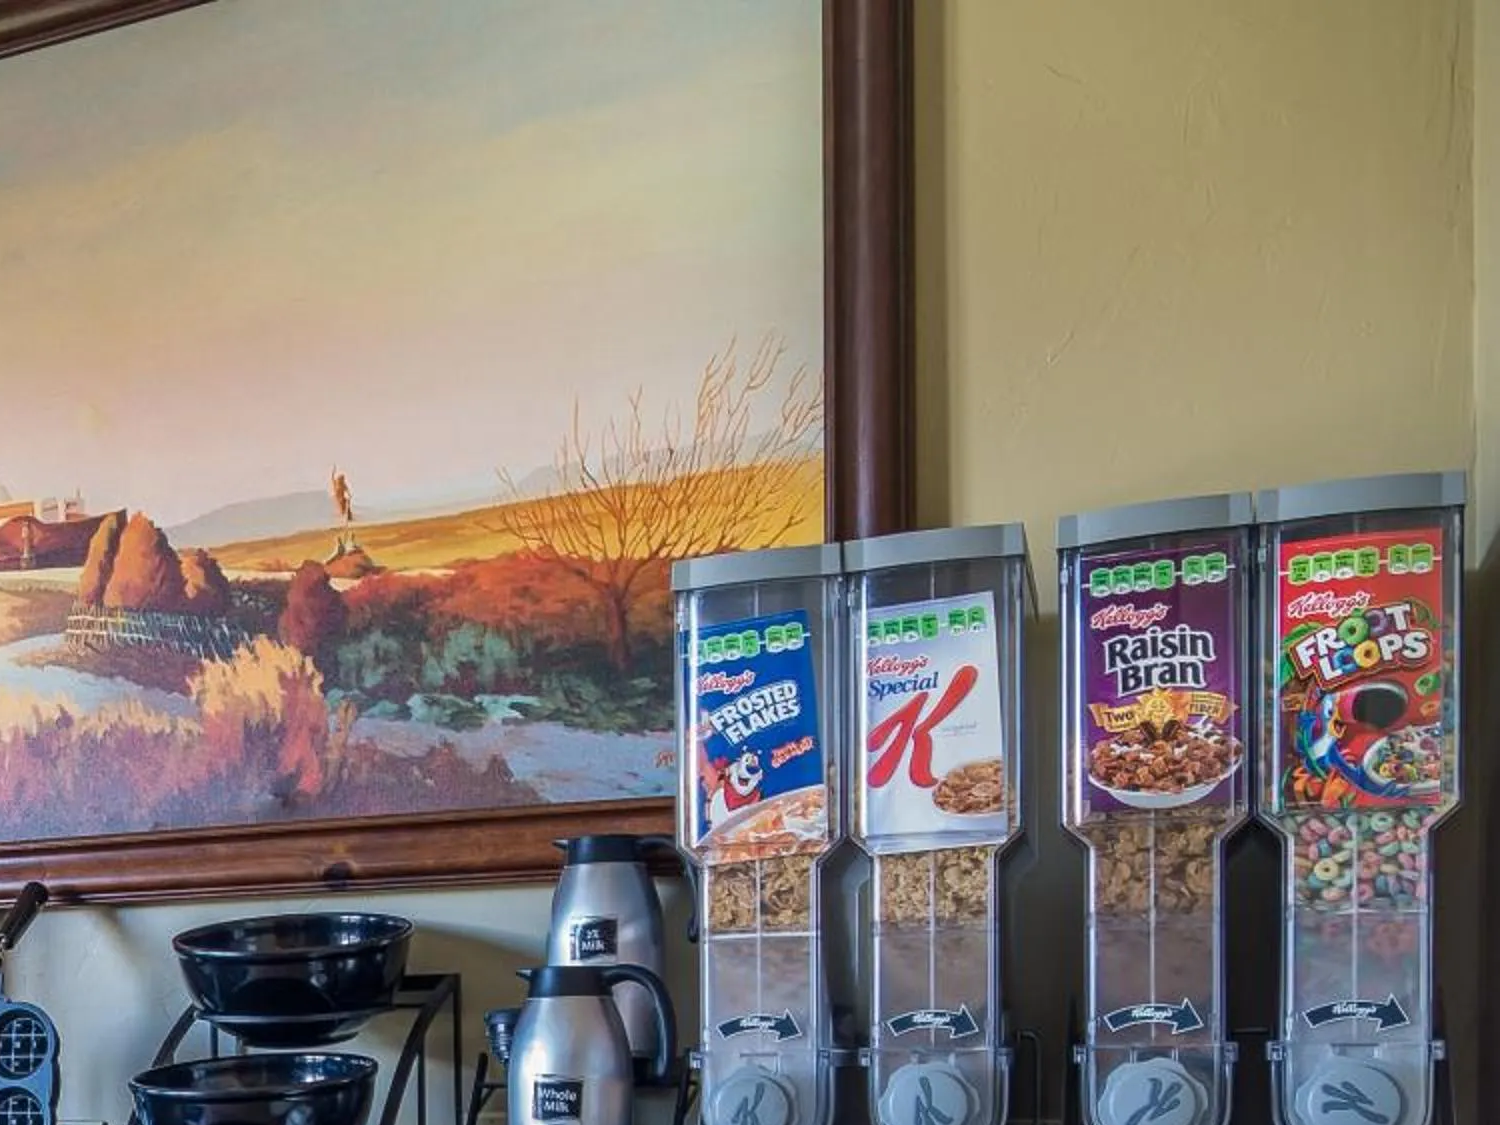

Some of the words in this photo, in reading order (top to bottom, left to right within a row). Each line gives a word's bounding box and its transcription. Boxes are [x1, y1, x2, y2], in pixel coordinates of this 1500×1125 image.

[1090, 602, 1169, 630] Kellogg's
[1287, 590, 1371, 618] Kellogg's
[1105, 624, 1215, 673] Raisin
[1295, 603, 1412, 669] FROOT
[1319, 631, 1429, 681] LOOPS
[867, 671, 939, 702] Special
[1119, 660, 1206, 696] Bran
[709, 682, 798, 731] FROSTED
[724, 699, 801, 745] FLAKES
[538, 1087, 578, 1102] Whole
[543, 1101, 570, 1113] Milk
